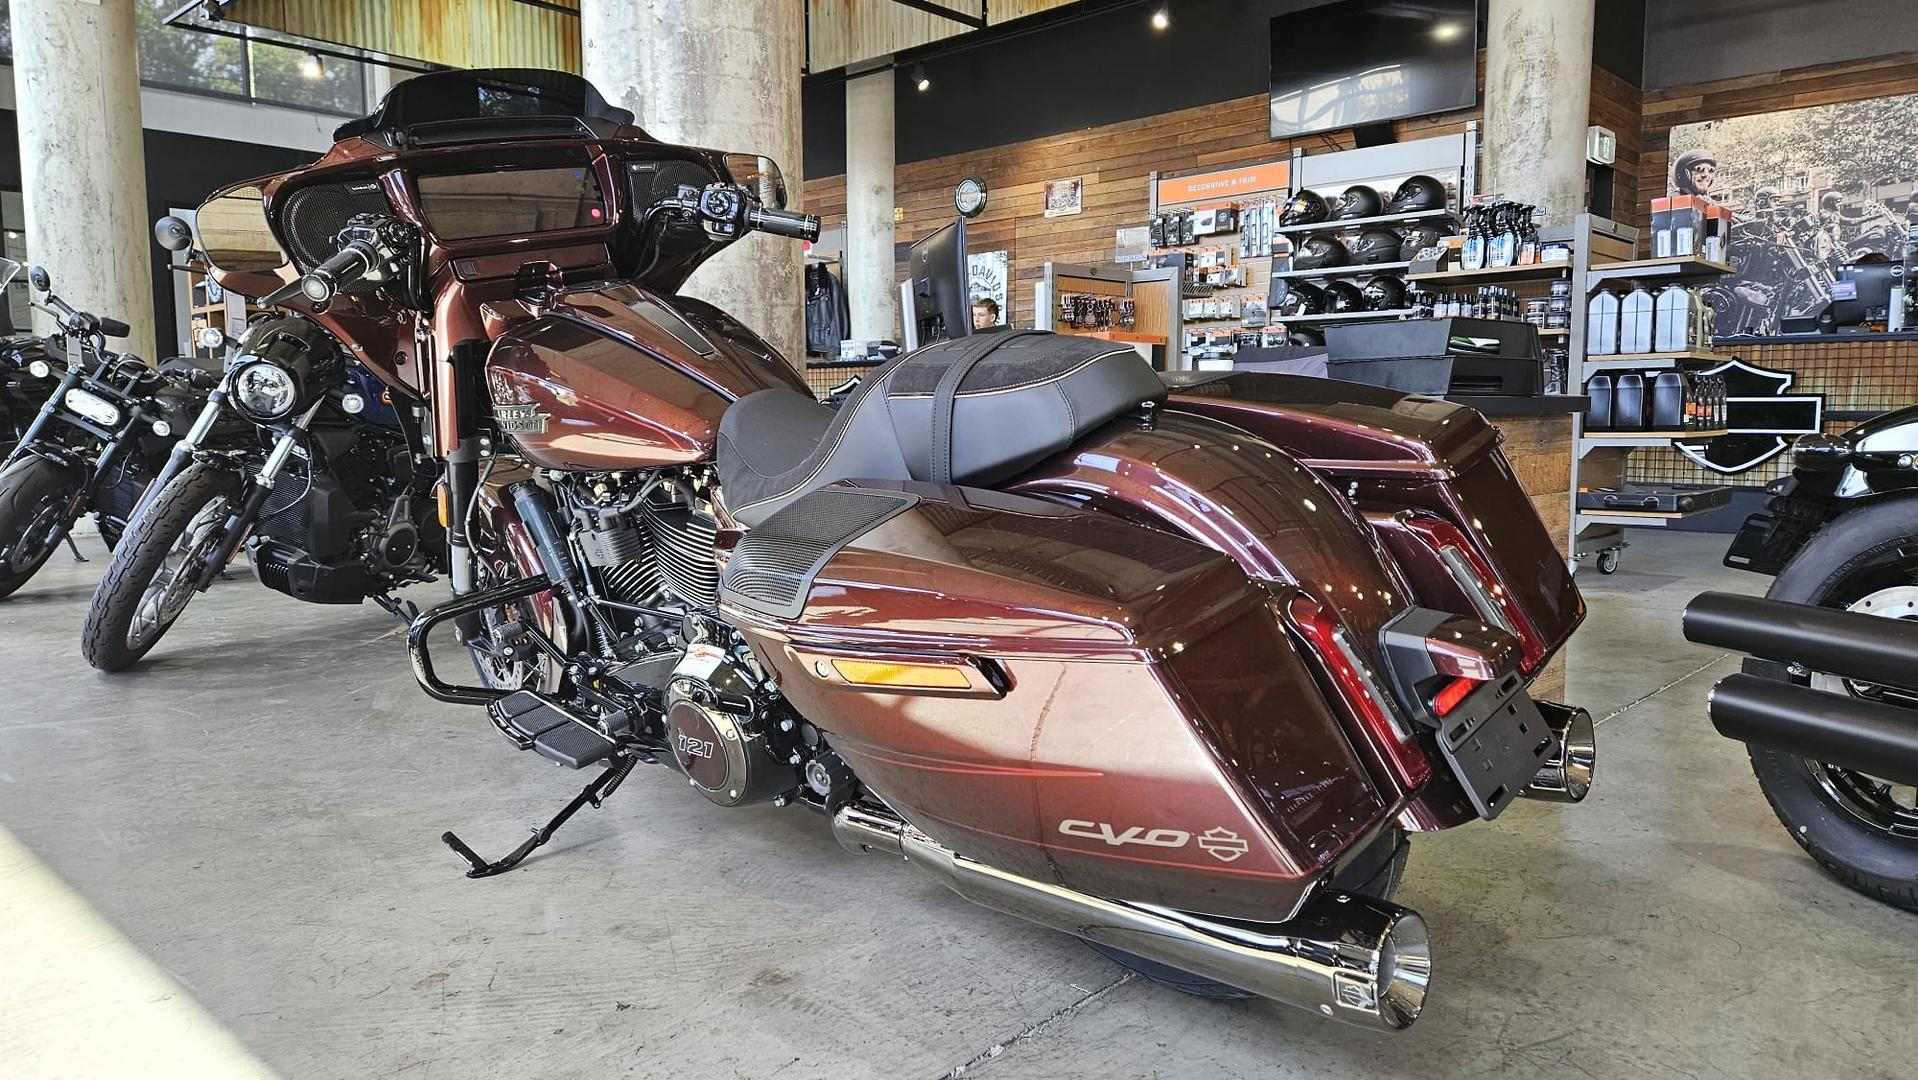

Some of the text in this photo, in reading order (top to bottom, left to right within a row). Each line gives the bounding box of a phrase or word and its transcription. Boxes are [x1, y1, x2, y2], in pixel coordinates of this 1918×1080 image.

[1188, 179, 1230, 192] DECORATIVE
[1239, 175, 1257, 186] TRIM
[677, 733, 714, 759] 121
[1058, 819, 1190, 848] CVO
